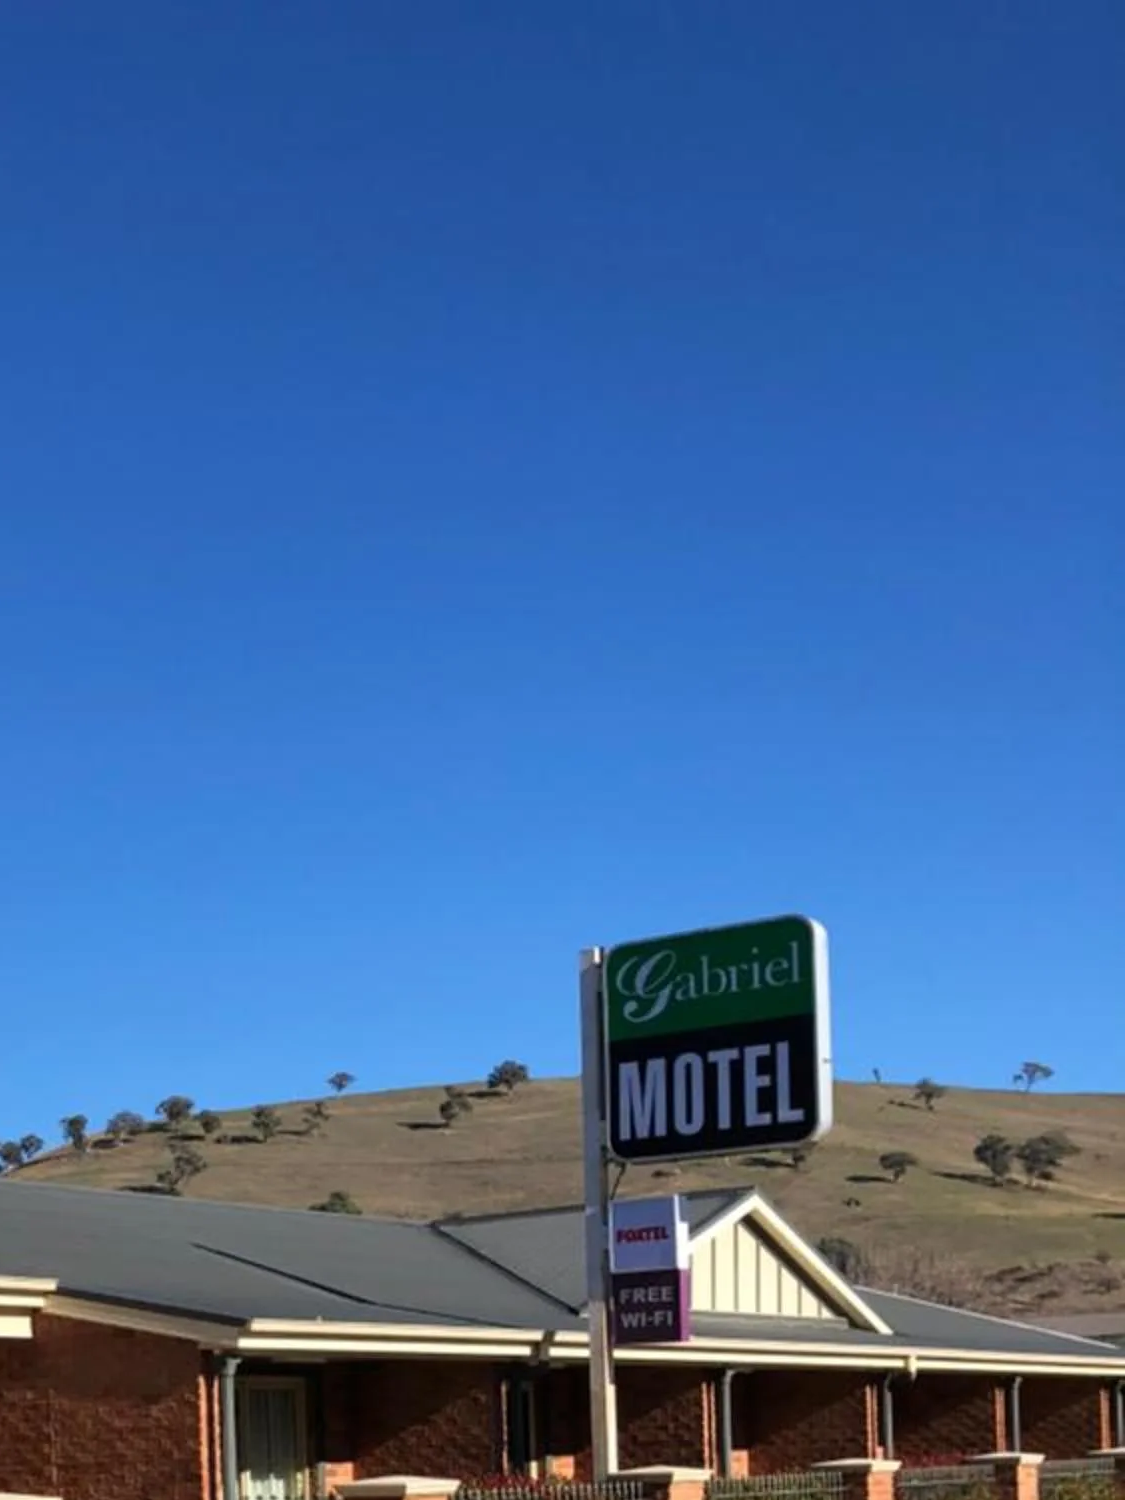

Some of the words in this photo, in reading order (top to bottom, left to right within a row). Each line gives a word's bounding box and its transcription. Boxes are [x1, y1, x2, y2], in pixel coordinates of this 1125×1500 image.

[615, 940, 801, 1023] Gabriel
[618, 1040, 805, 1142] MOTEL
[619, 1285, 674, 1304] FREE
[620, 1310, 673, 1329] WI-FI
